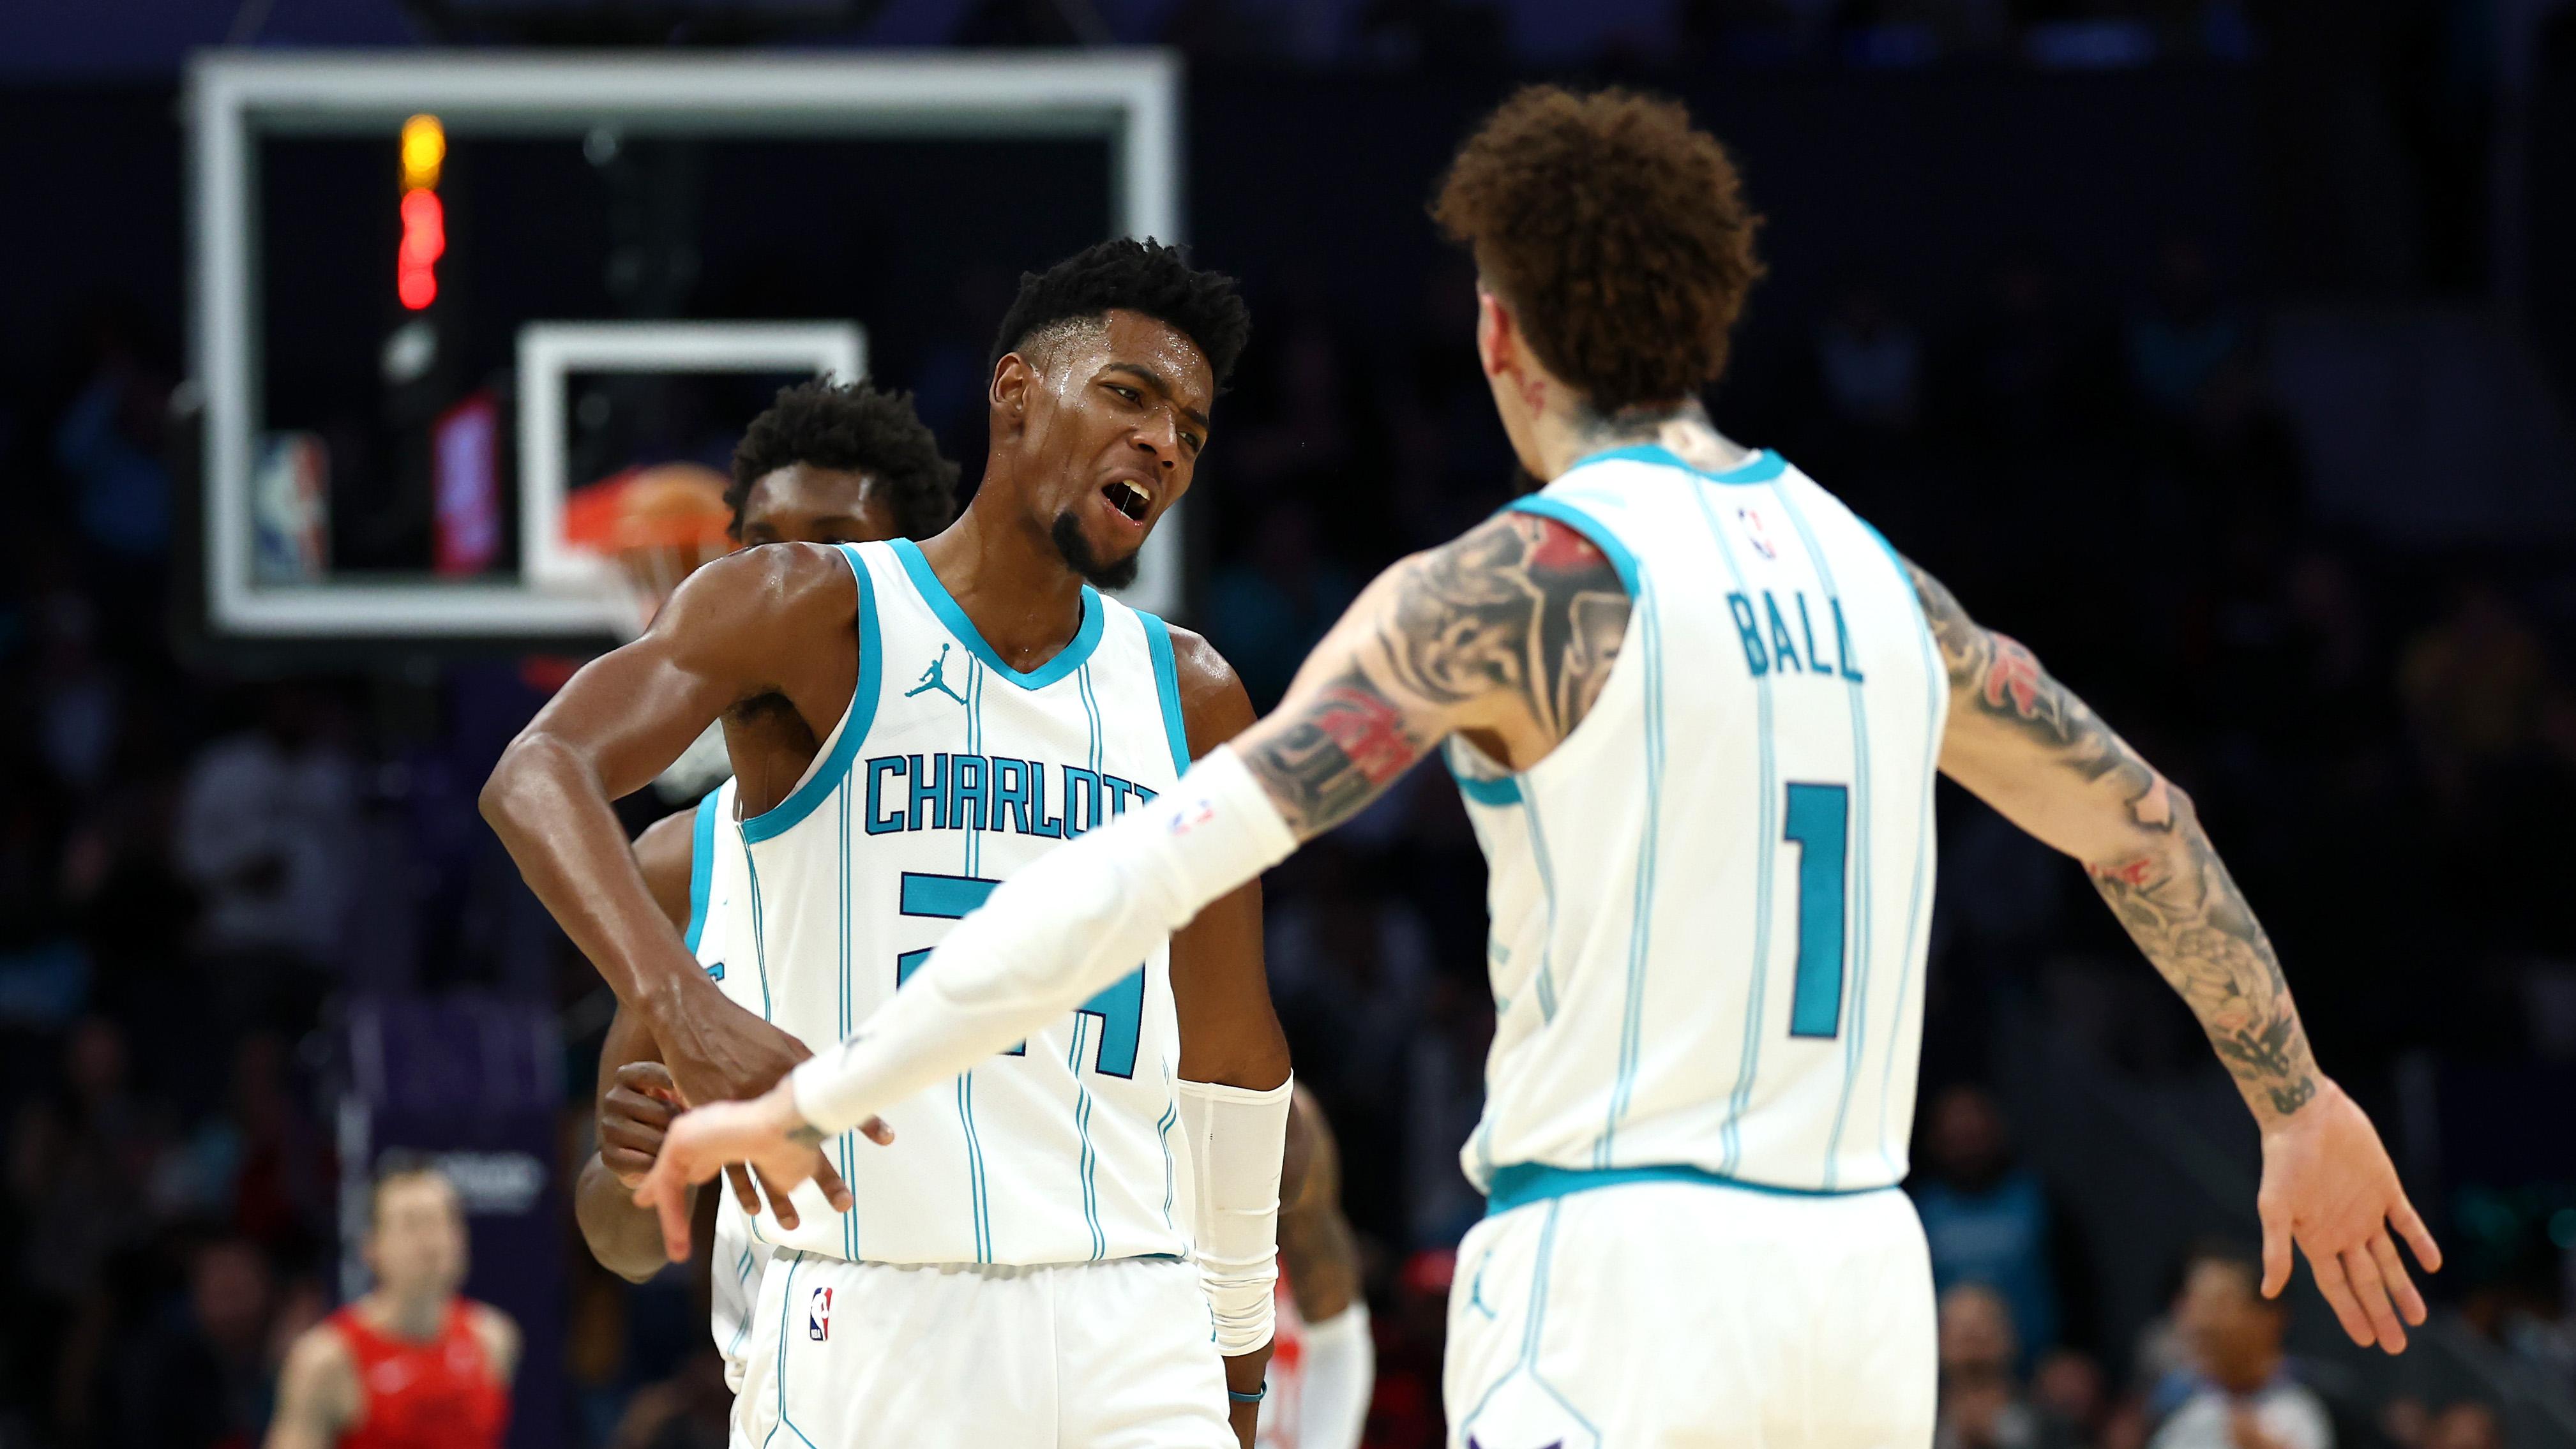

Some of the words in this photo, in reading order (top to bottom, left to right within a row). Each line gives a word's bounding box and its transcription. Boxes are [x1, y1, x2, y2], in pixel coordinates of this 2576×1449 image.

[1726, 589, 1864, 682] BALL
[865, 753, 1159, 840] CHARLOT
[1783, 781, 1848, 1039] 1
